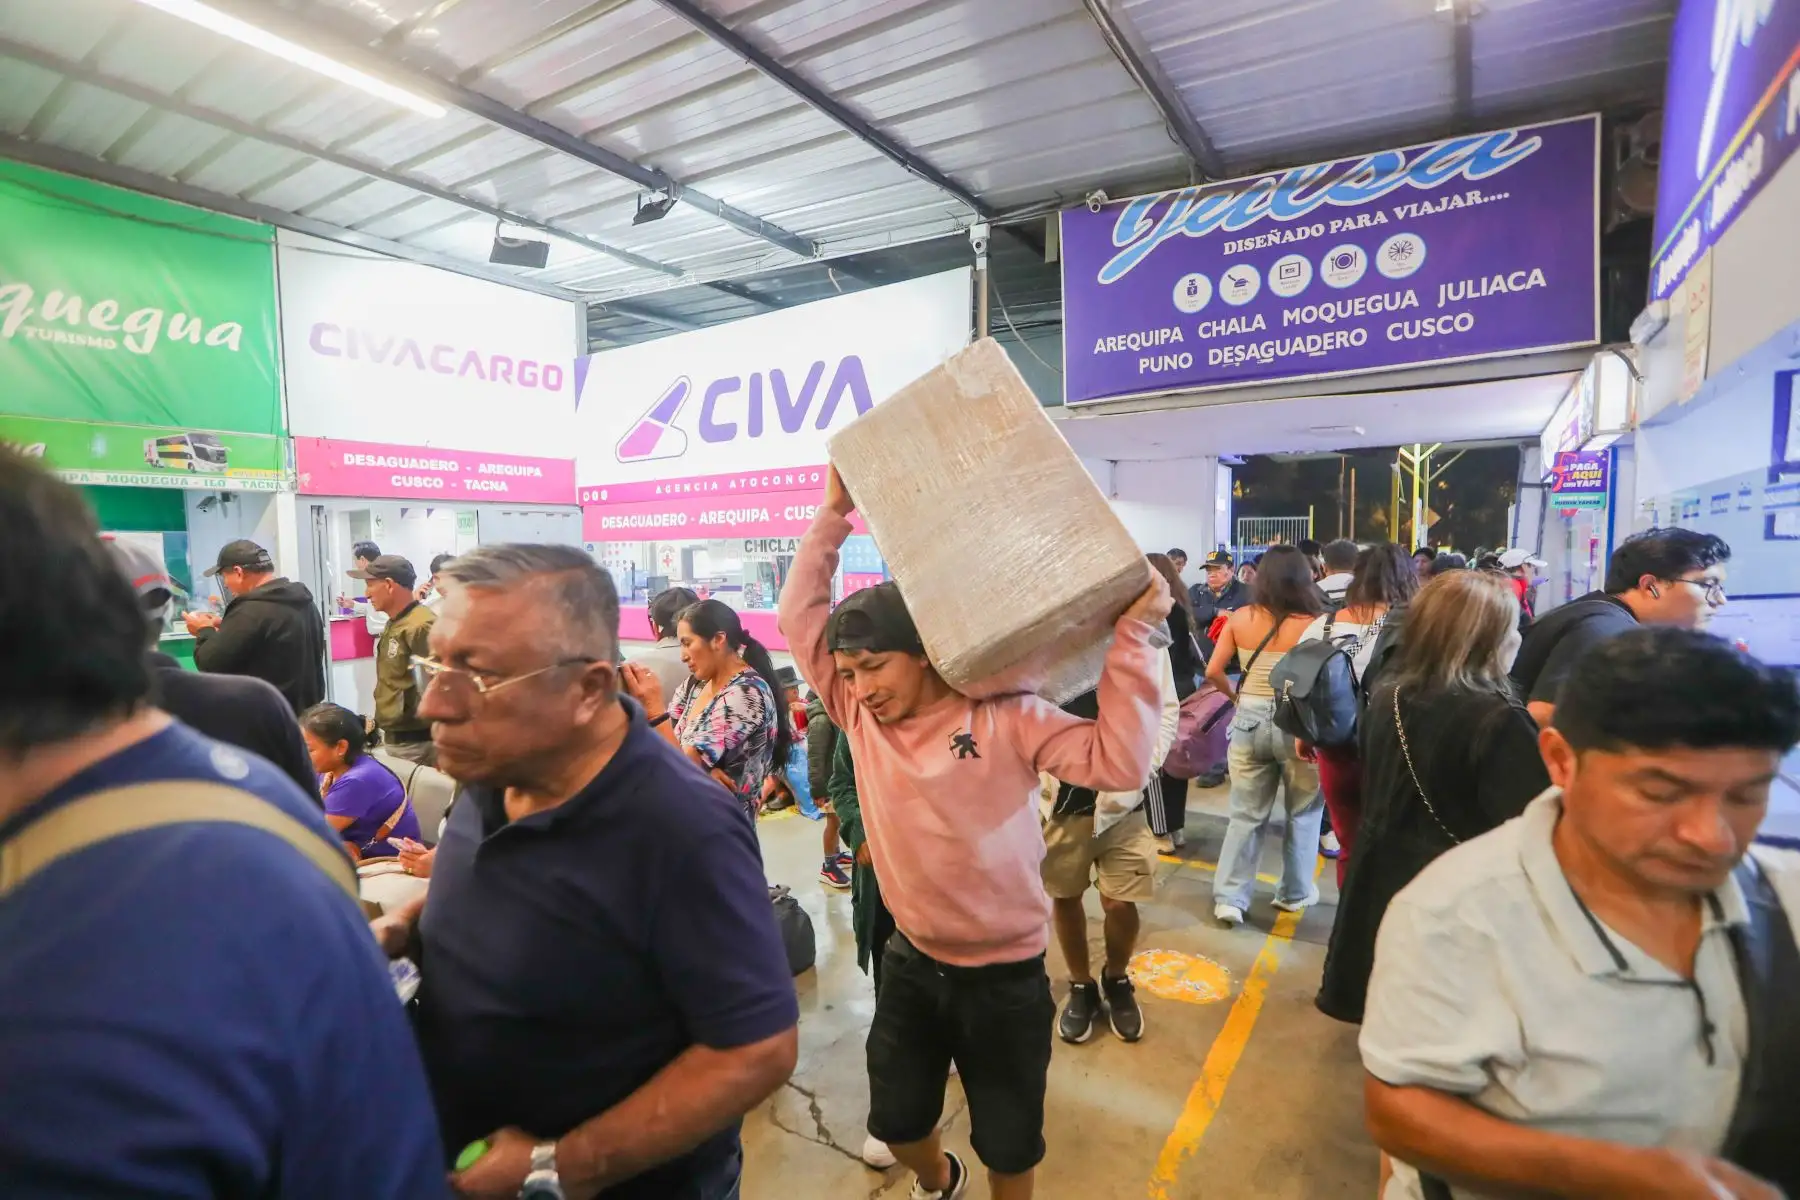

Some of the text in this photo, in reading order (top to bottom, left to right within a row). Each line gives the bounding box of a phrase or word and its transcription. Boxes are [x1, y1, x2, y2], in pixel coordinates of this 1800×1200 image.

[1223, 223, 1325, 256] DISEÑADO
[1329, 210, 1388, 234] PARA
[1093, 267, 1547, 355] AREQUIPA CHALA MOQUEGUA JULIACA
[24, 326, 117, 350] TURISMO
[1139, 312, 1474, 374] PUNO DESAGUADERO CUSCO
[308, 321, 564, 392] CIVACARGO
[698, 355, 875, 444] CIVA
[343, 452, 460, 472] DESAGUADERO
[478, 462, 543, 478] AREQUIPA
[1570, 463, 1598, 471] PAGA
[106, 474, 189, 487] MOQUEGUA
[204, 478, 226, 488] ILO
[240, 480, 284, 490] TACNA
[391, 474, 444, 489] CUSCO
[463, 479, 509, 493] TACNA
[655, 472, 820, 495] AGENCIA ATOCONGO
[601, 512, 687, 530] DESAGUADERO
[698, 507, 770, 527] AREQUIPA
